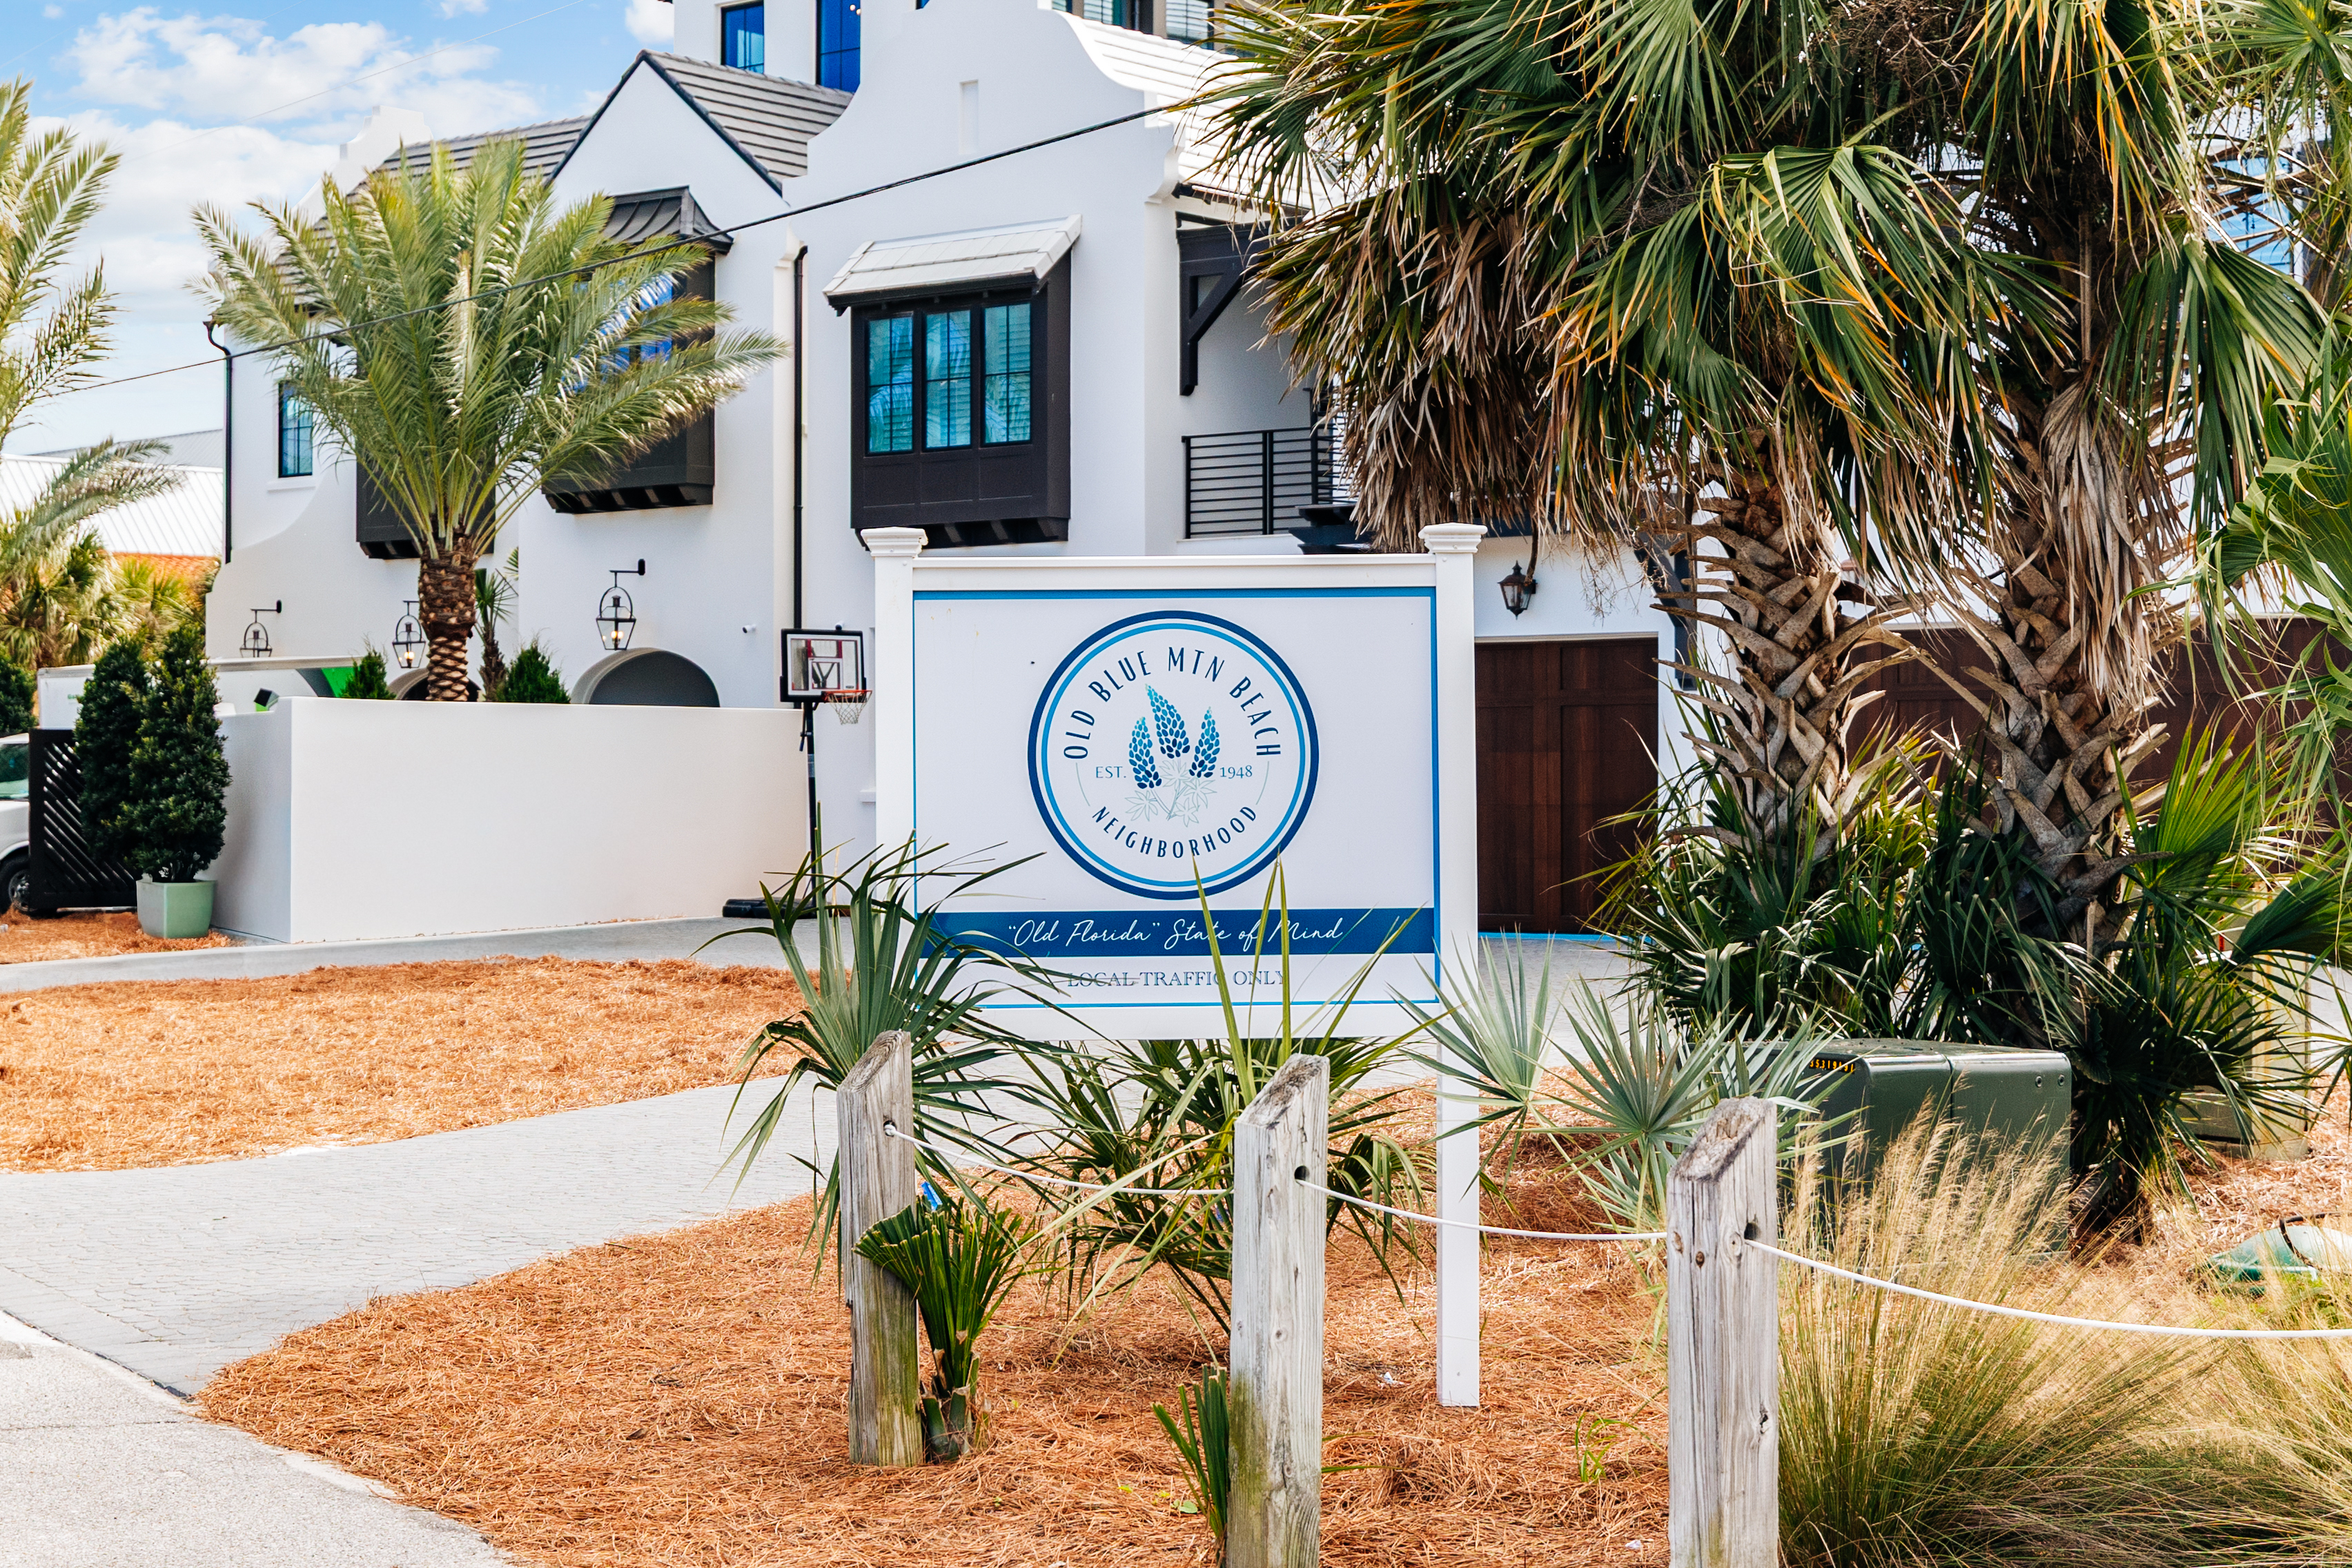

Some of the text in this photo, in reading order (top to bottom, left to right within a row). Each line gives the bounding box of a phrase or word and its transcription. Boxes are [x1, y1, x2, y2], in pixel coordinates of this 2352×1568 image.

[1064, 647, 1282, 759] OLD BLUE MTN BEACH
[1095, 765, 1253, 779] EST. 1948
[1092, 805, 1257, 859] NEIGHBORHOOD
[1164, 919, 1232, 950] State
[1238, 919, 1263, 952] of
[1267, 917, 1344, 943] Mind
[1067, 972, 1136, 987] LOCAL
